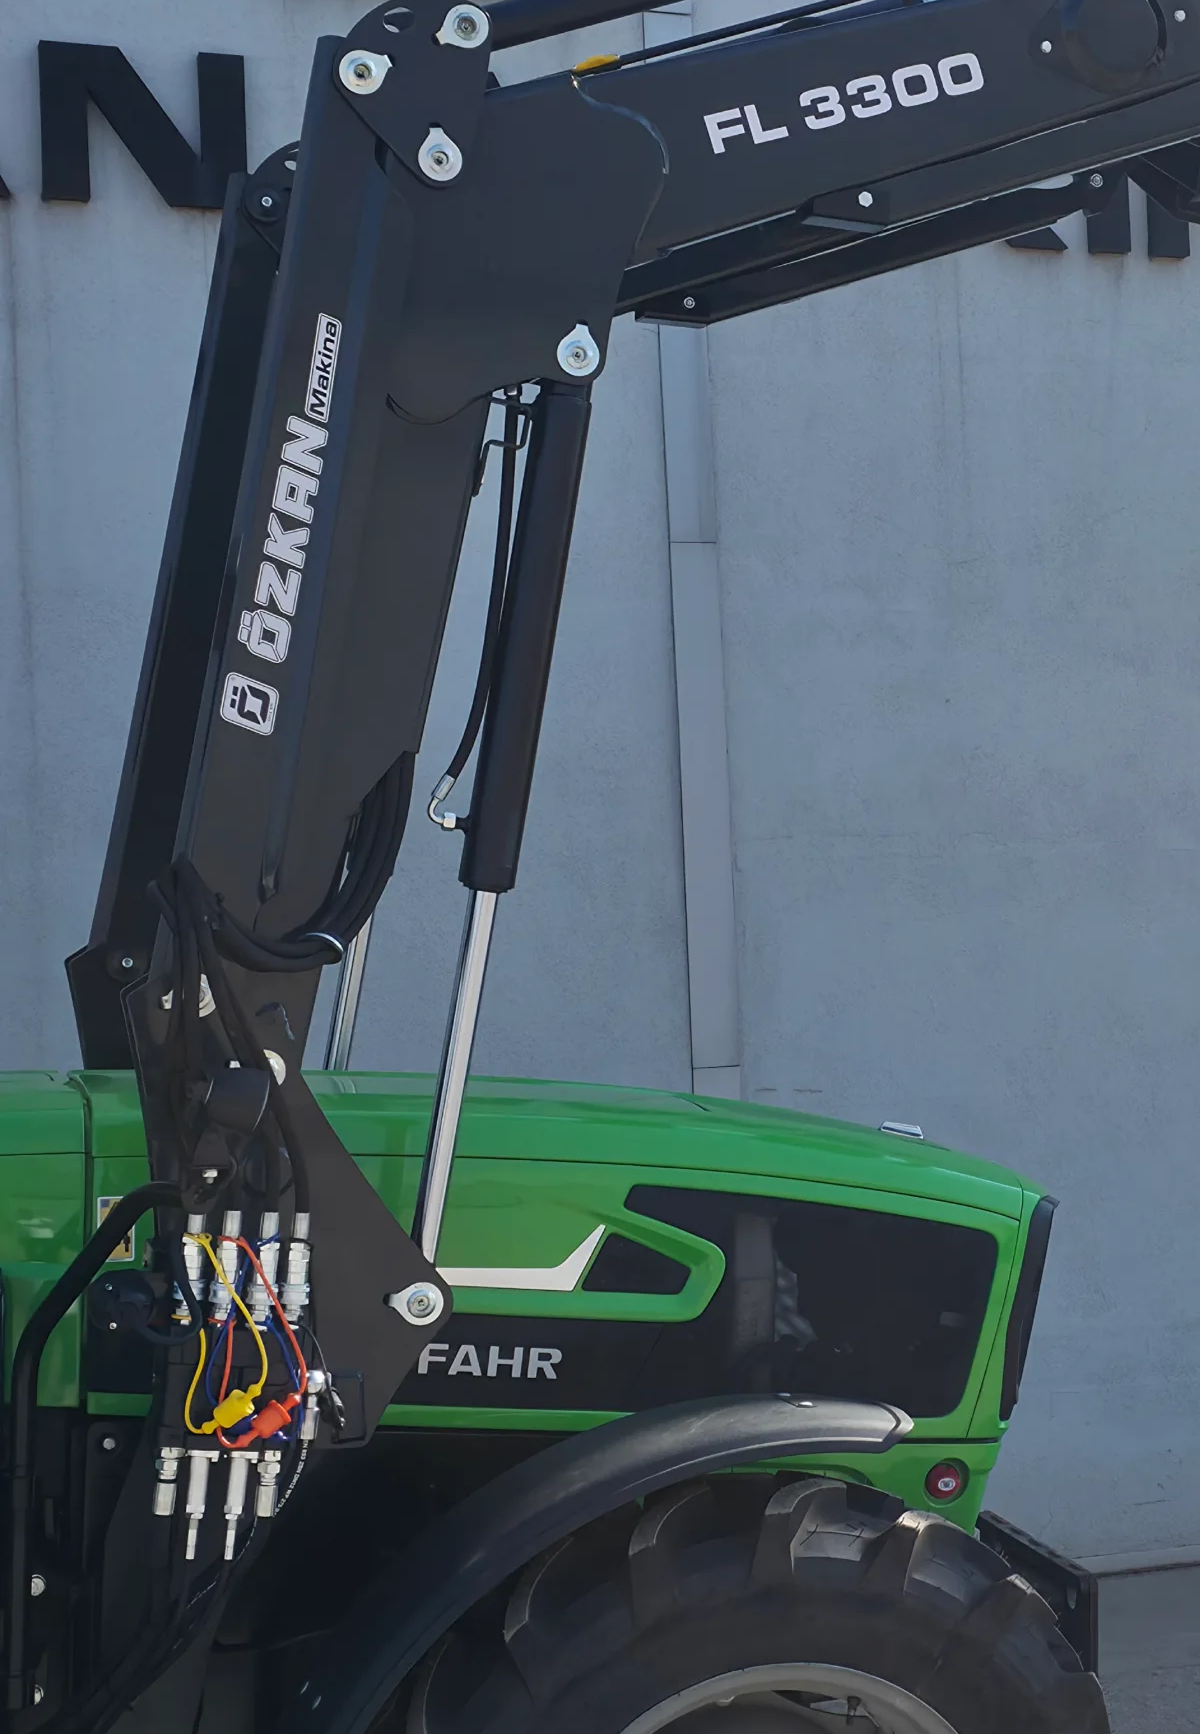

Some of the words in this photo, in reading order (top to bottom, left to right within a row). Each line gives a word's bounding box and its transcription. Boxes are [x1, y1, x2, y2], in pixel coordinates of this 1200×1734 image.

[703, 103, 790, 155] FL
[798, 52, 985, 130] 3300
[237, 415, 329, 664] ÖZKAN
[309, 320, 339, 418] Makina
[417, 1343, 563, 1380] FAHR
